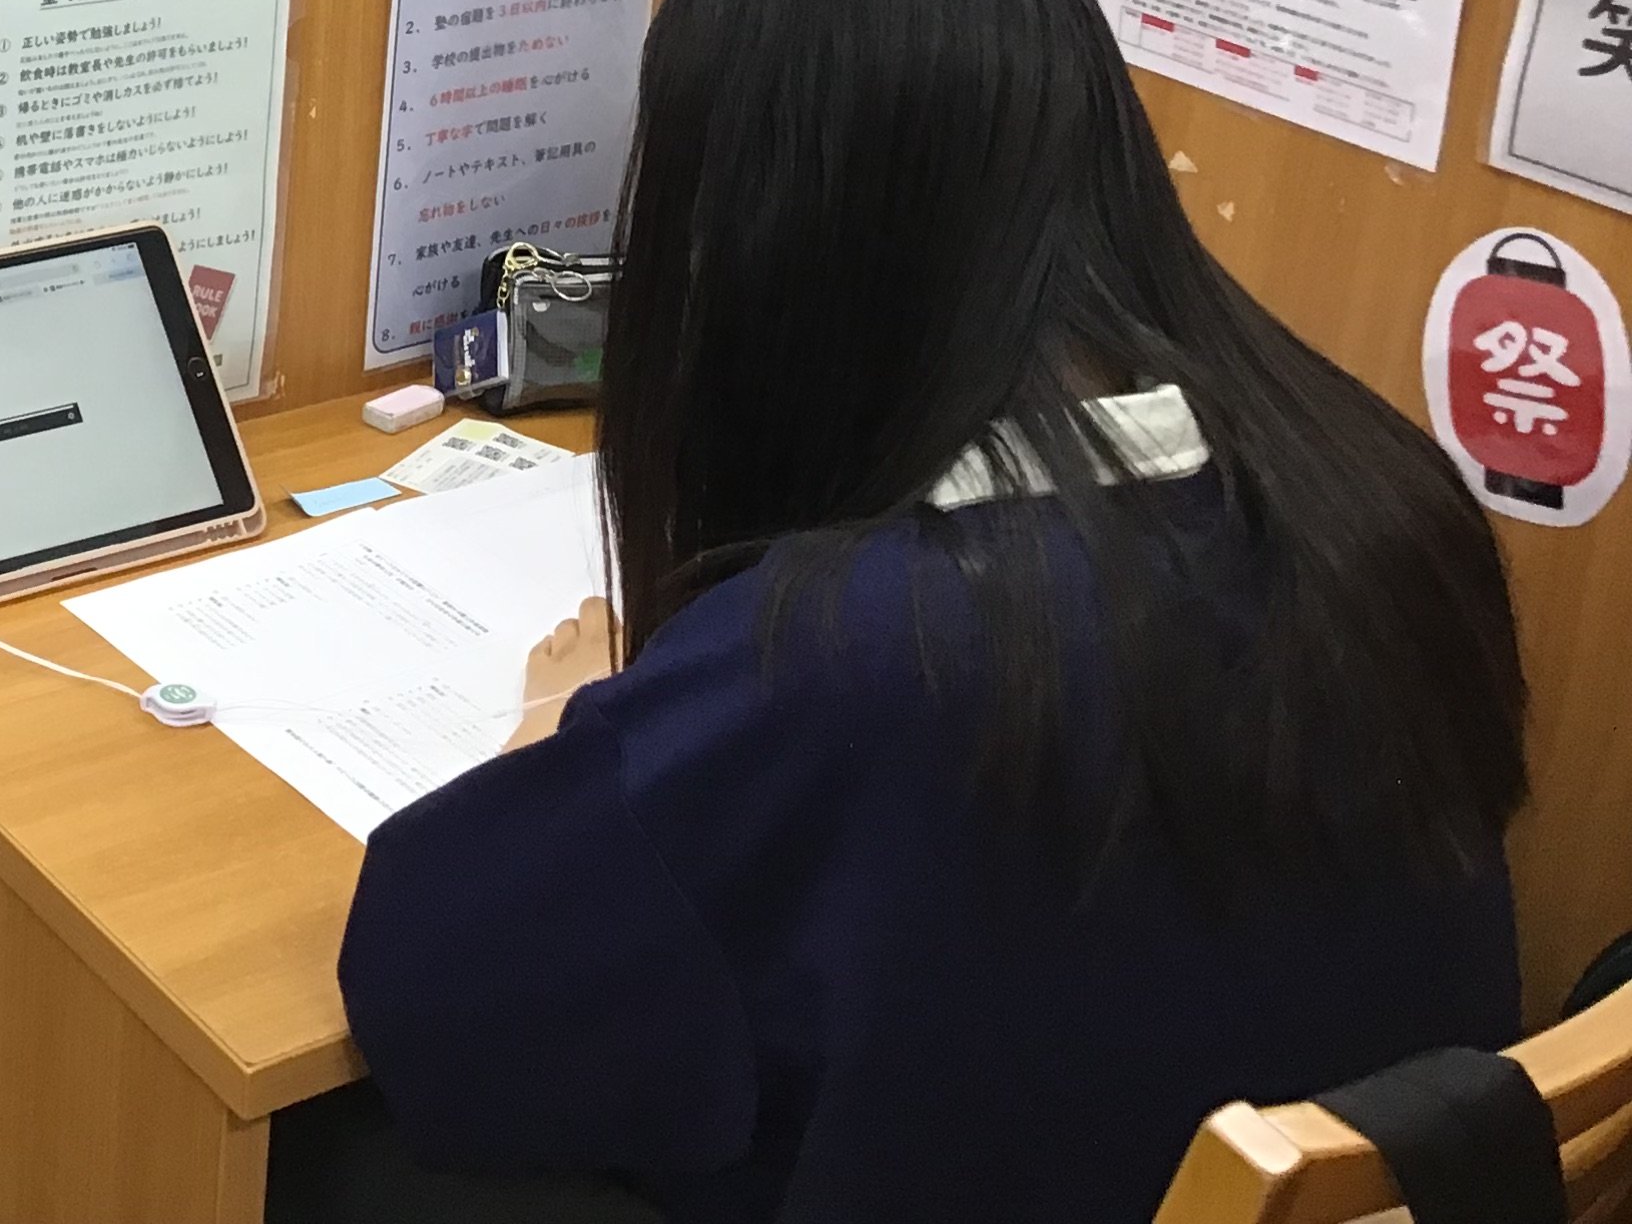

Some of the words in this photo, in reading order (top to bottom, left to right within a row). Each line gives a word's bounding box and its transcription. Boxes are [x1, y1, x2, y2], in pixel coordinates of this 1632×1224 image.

[424, 111, 548, 147] 丁寧な字で問題を解く
[418, 193, 506, 223] 忘れ物をしない
[192, 284, 225, 302] RULE
[411, 275, 461, 298] 心がける
[1474, 319, 1581, 436] 祭
